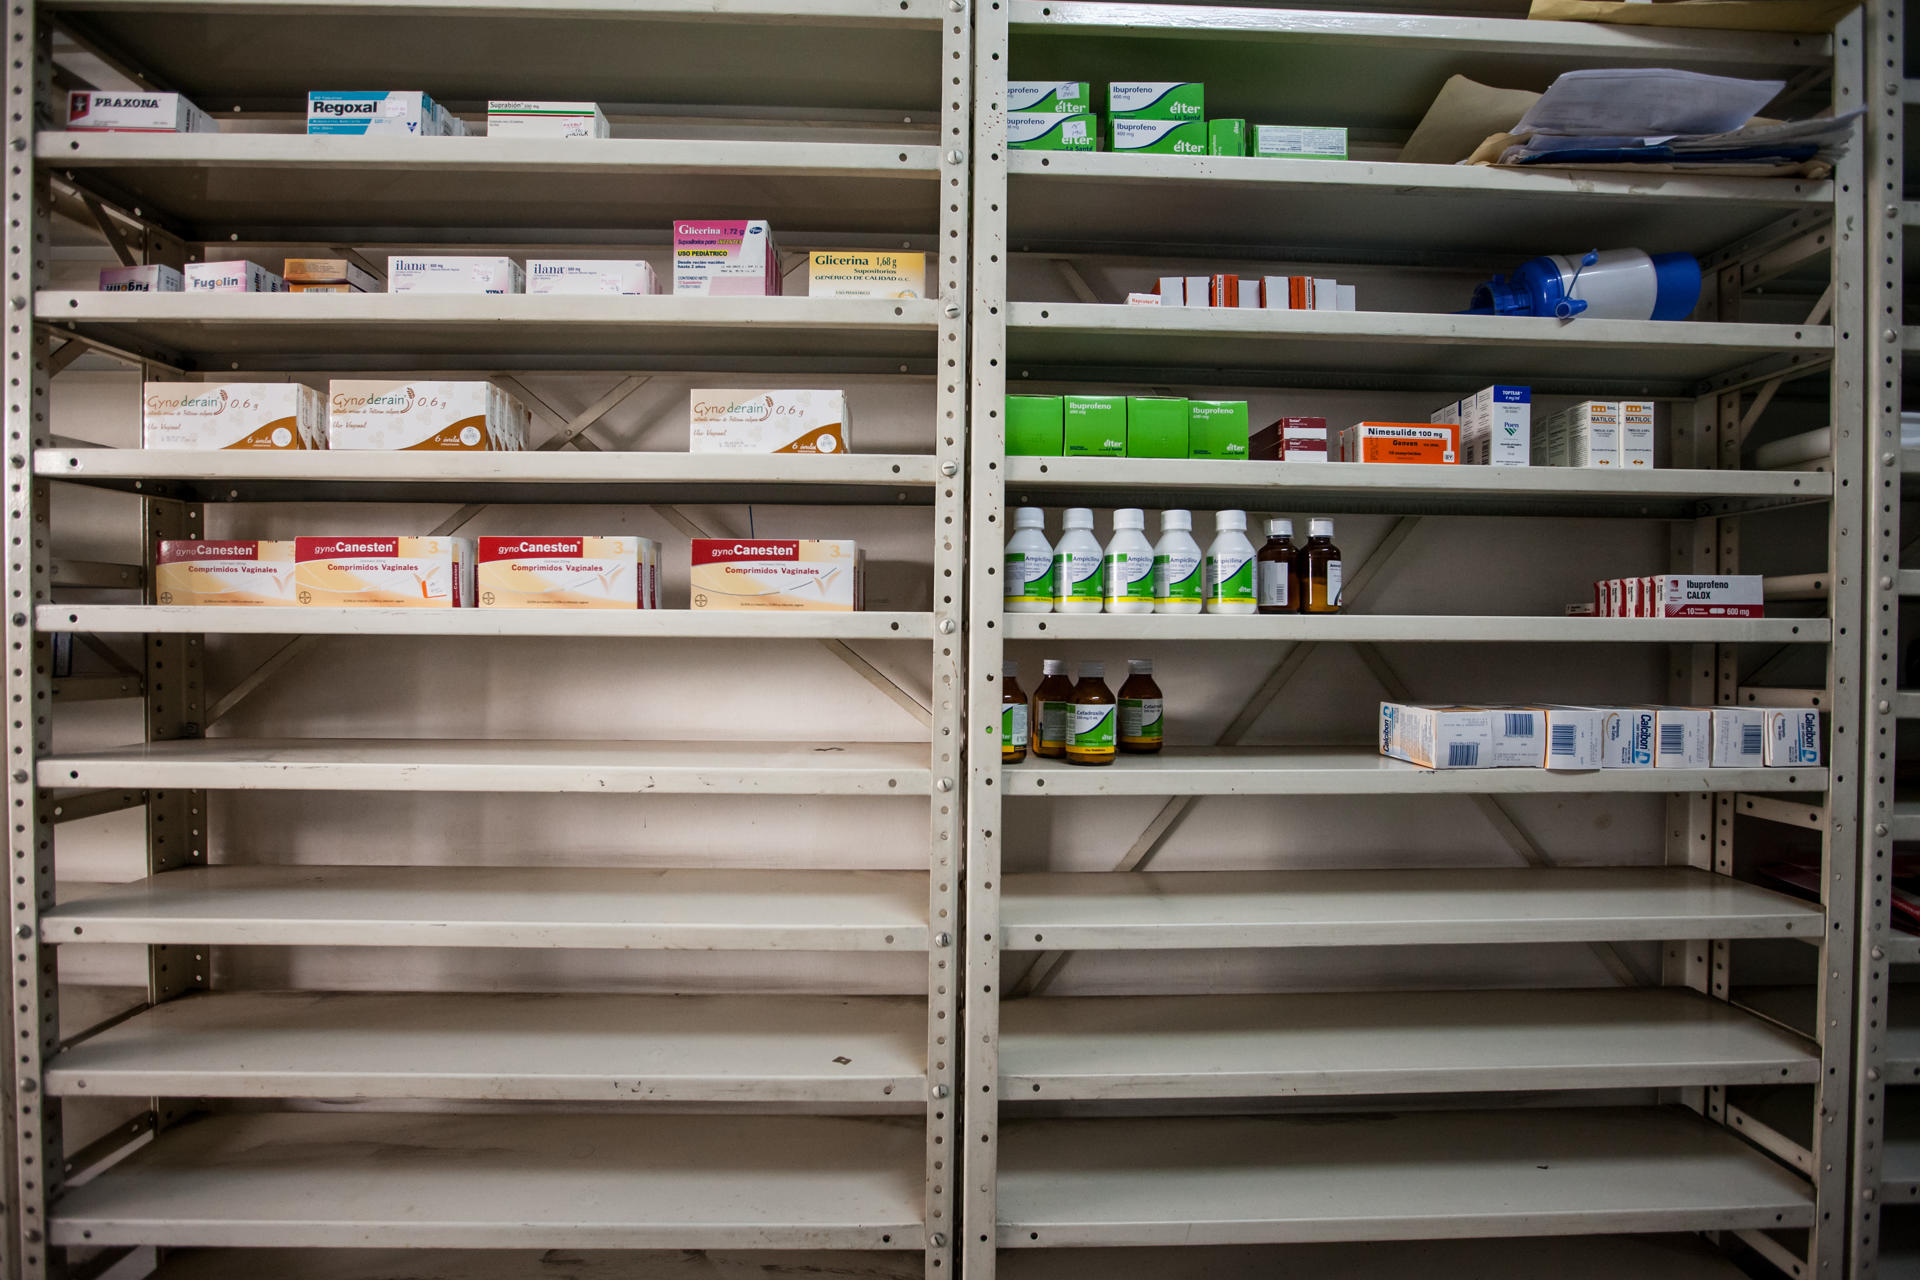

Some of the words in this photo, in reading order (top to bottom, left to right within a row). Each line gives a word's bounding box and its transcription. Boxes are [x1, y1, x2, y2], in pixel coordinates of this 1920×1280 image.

[1113, 86, 1152, 94] Ibuprofeno
[95, 98, 159, 108] PRAXONA
[313, 101, 377, 116] Regoxal
[1055, 100, 1086, 112] élter
[1170, 101, 1200, 114] élter
[1007, 118, 1045, 126] buprofeno
[1117, 123, 1156, 131] Ibuprofeno
[1174, 140, 1204, 152] élter
[679, 224, 720, 234] Glicerina
[396, 260, 425, 271] ilana
[815, 255, 869, 265] Glicerina
[876, 257, 891, 266] 1,68
[892, 259, 897, 269] g
[534, 263, 563, 274] ilana
[194, 278, 238, 289] Fugolin
[148, 394, 217, 409] Gynoderain
[231, 399, 250, 409] 0.6
[333, 393, 404, 408] Gynoderain
[418, 396, 438, 407] 0.6
[1070, 402, 1111, 410] Ibuprofeno
[694, 401, 763, 416] Gynoderain
[776, 406, 796, 415] 0.6
[1193, 407, 1234, 415] Ibuprofeno
[1368, 428, 1416, 437] Nimesulide
[429, 541, 438, 554] 3
[614, 541, 624, 554] 3
[830, 545, 840, 557] 3
[327, 563, 378, 571] Comprimidos
[511, 564, 562, 572] Comprimidos
[565, 564, 603, 572] Vaginales
[725, 566, 777, 574] Comprimidos
[781, 567, 819, 575] Vaginales
[1687, 580, 1729, 590] Ibuprofeno
[1687, 591, 1710, 599] CALOX
[1640, 714, 1651, 749] Calcibon
[1805, 713, 1816, 748] Calcibon
